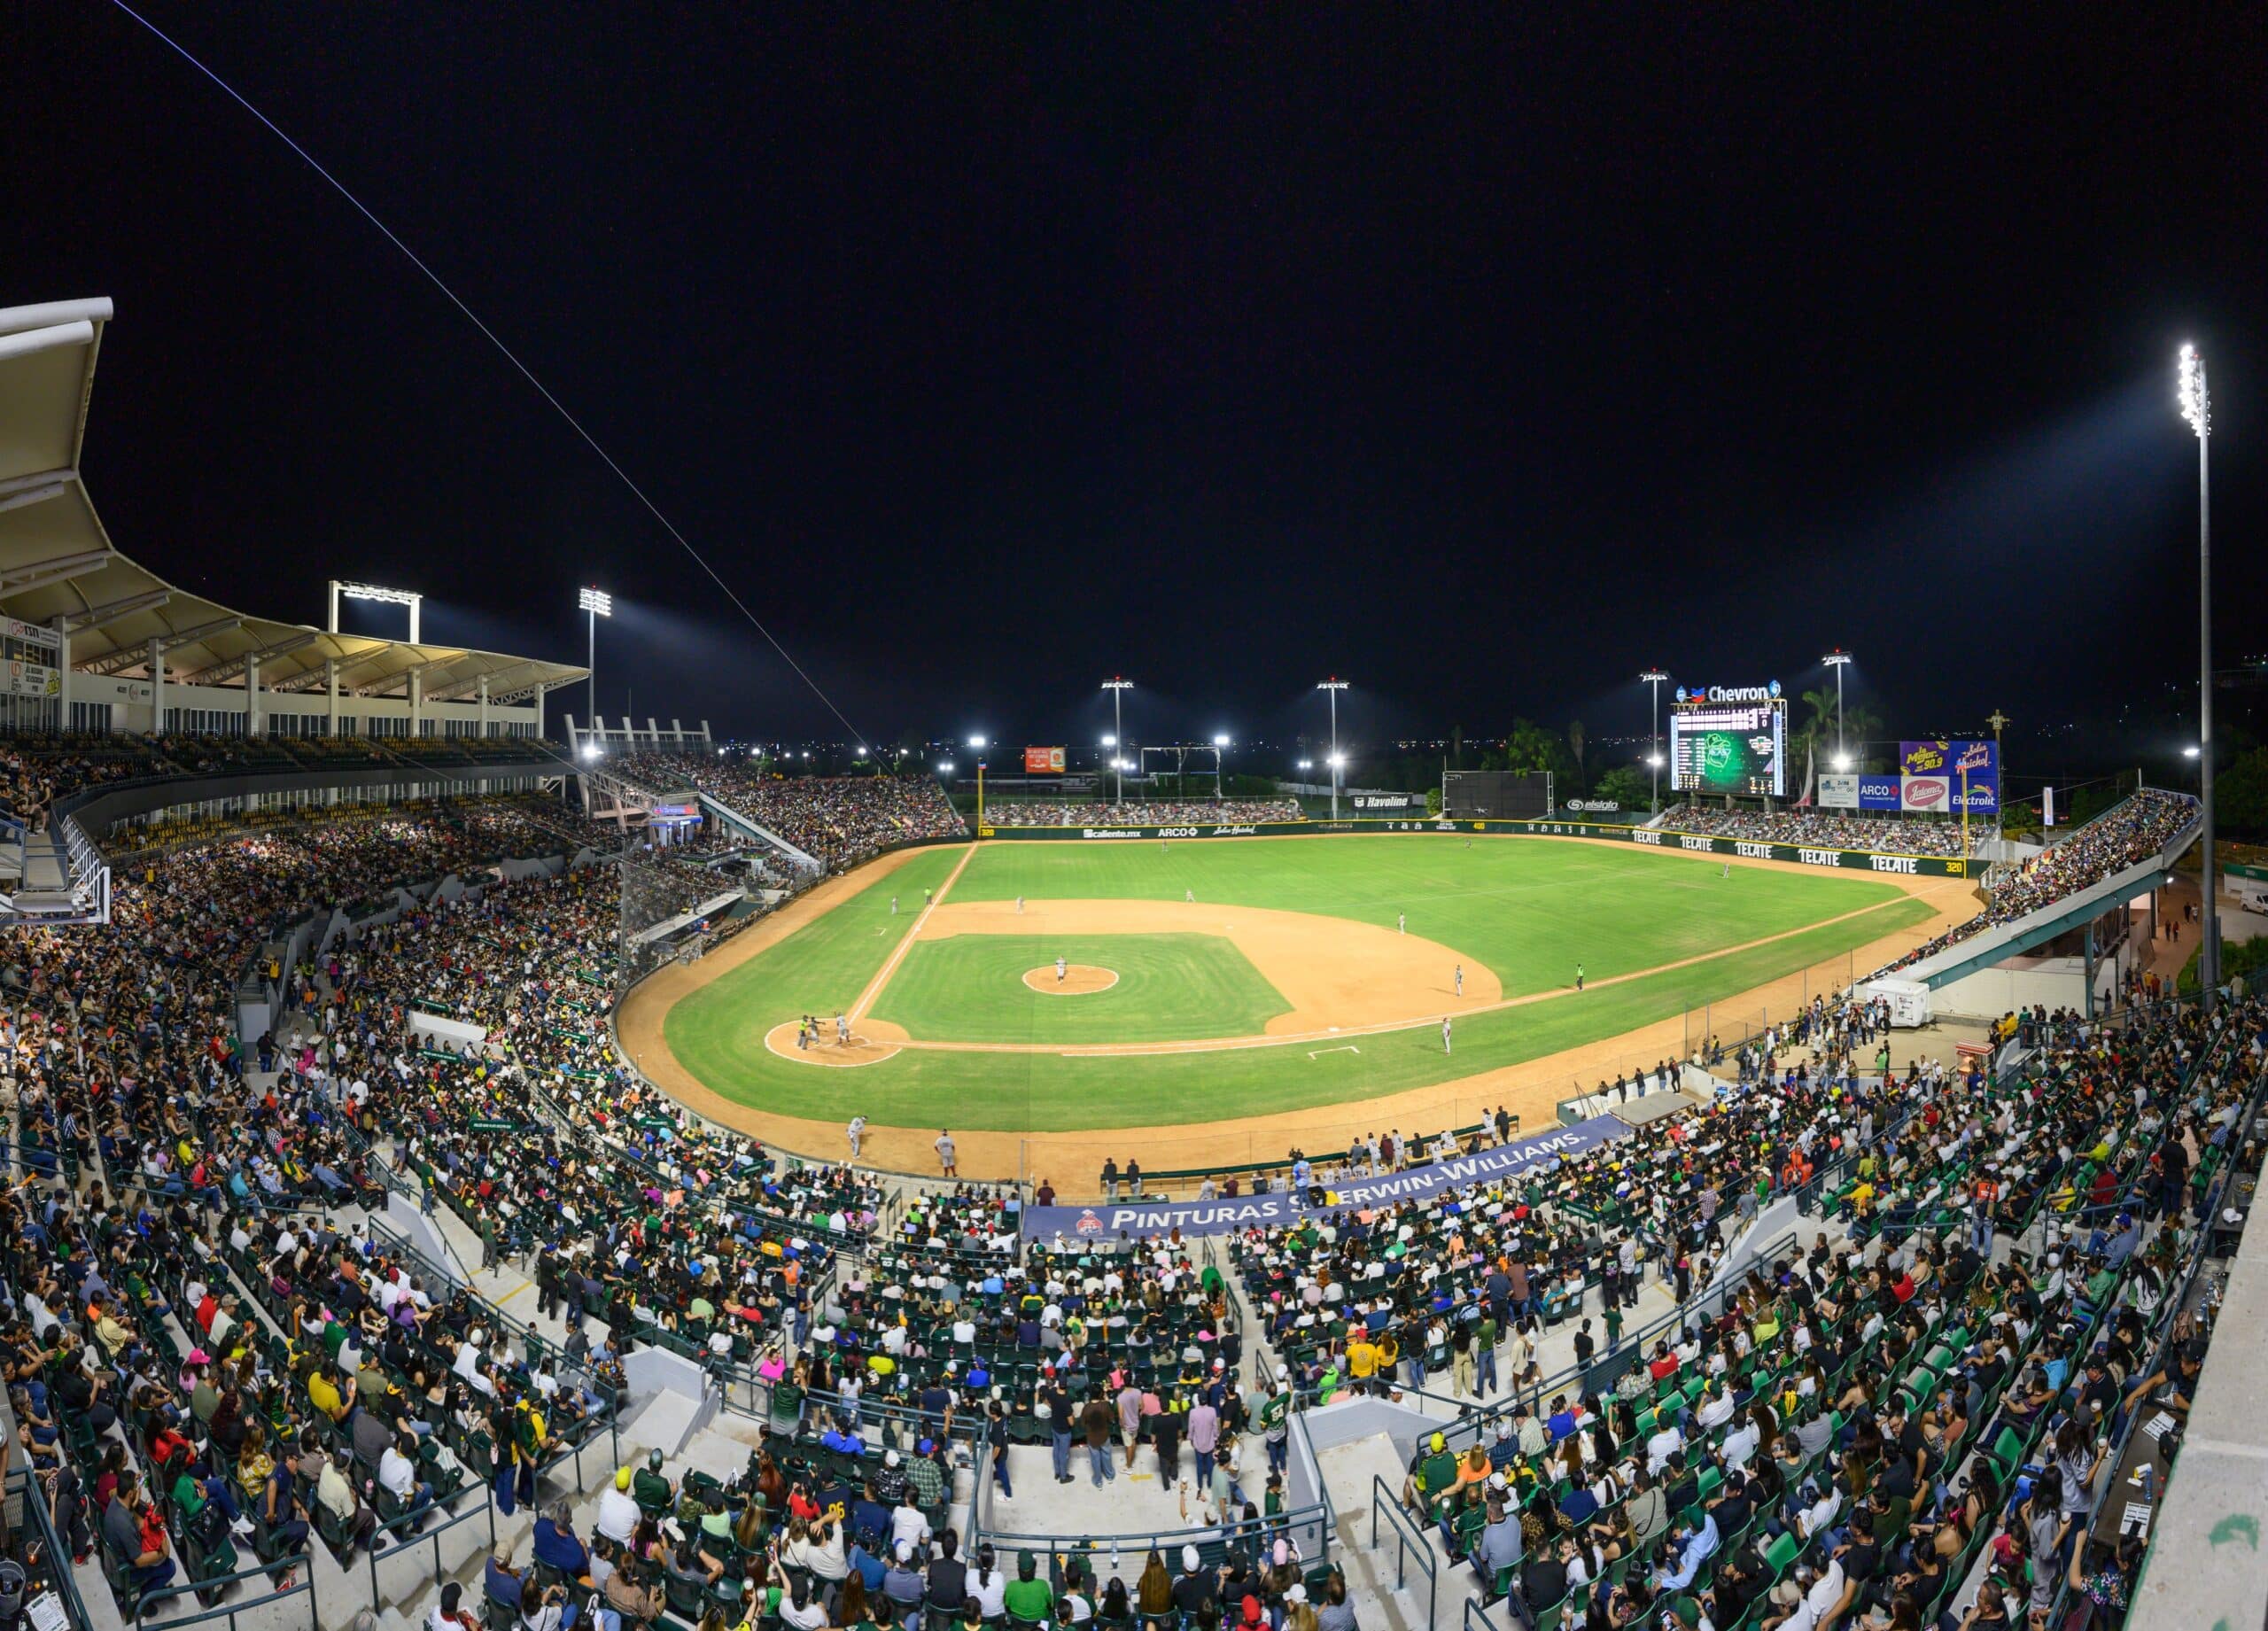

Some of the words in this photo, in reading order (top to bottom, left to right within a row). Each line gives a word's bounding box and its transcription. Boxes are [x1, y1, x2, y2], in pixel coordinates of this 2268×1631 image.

[1708, 686, 1768, 703] Chevron
[1924, 757, 1943, 770] 90.9
[1860, 785, 1889, 796] ARCO
[1367, 796, 1409, 809] Havoline
[1953, 795, 1995, 806] Elctrolit
[1092, 829, 1142, 838] caliente.mx
[1158, 828, 1188, 837] ARCO
[1632, 829, 1661, 845] TECATE
[1680, 835, 1714, 852] TECATE
[1735, 841, 1773, 859] TECATE
[1798, 848, 1842, 866] TECATE
[1868, 854, 1918, 874] TECATE
[1946, 861, 1962, 873] 320
[1111, 1200, 1279, 1231] PINTURAS
[1289, 1132, 1581, 1214] SERWIN-WILLIAMS
